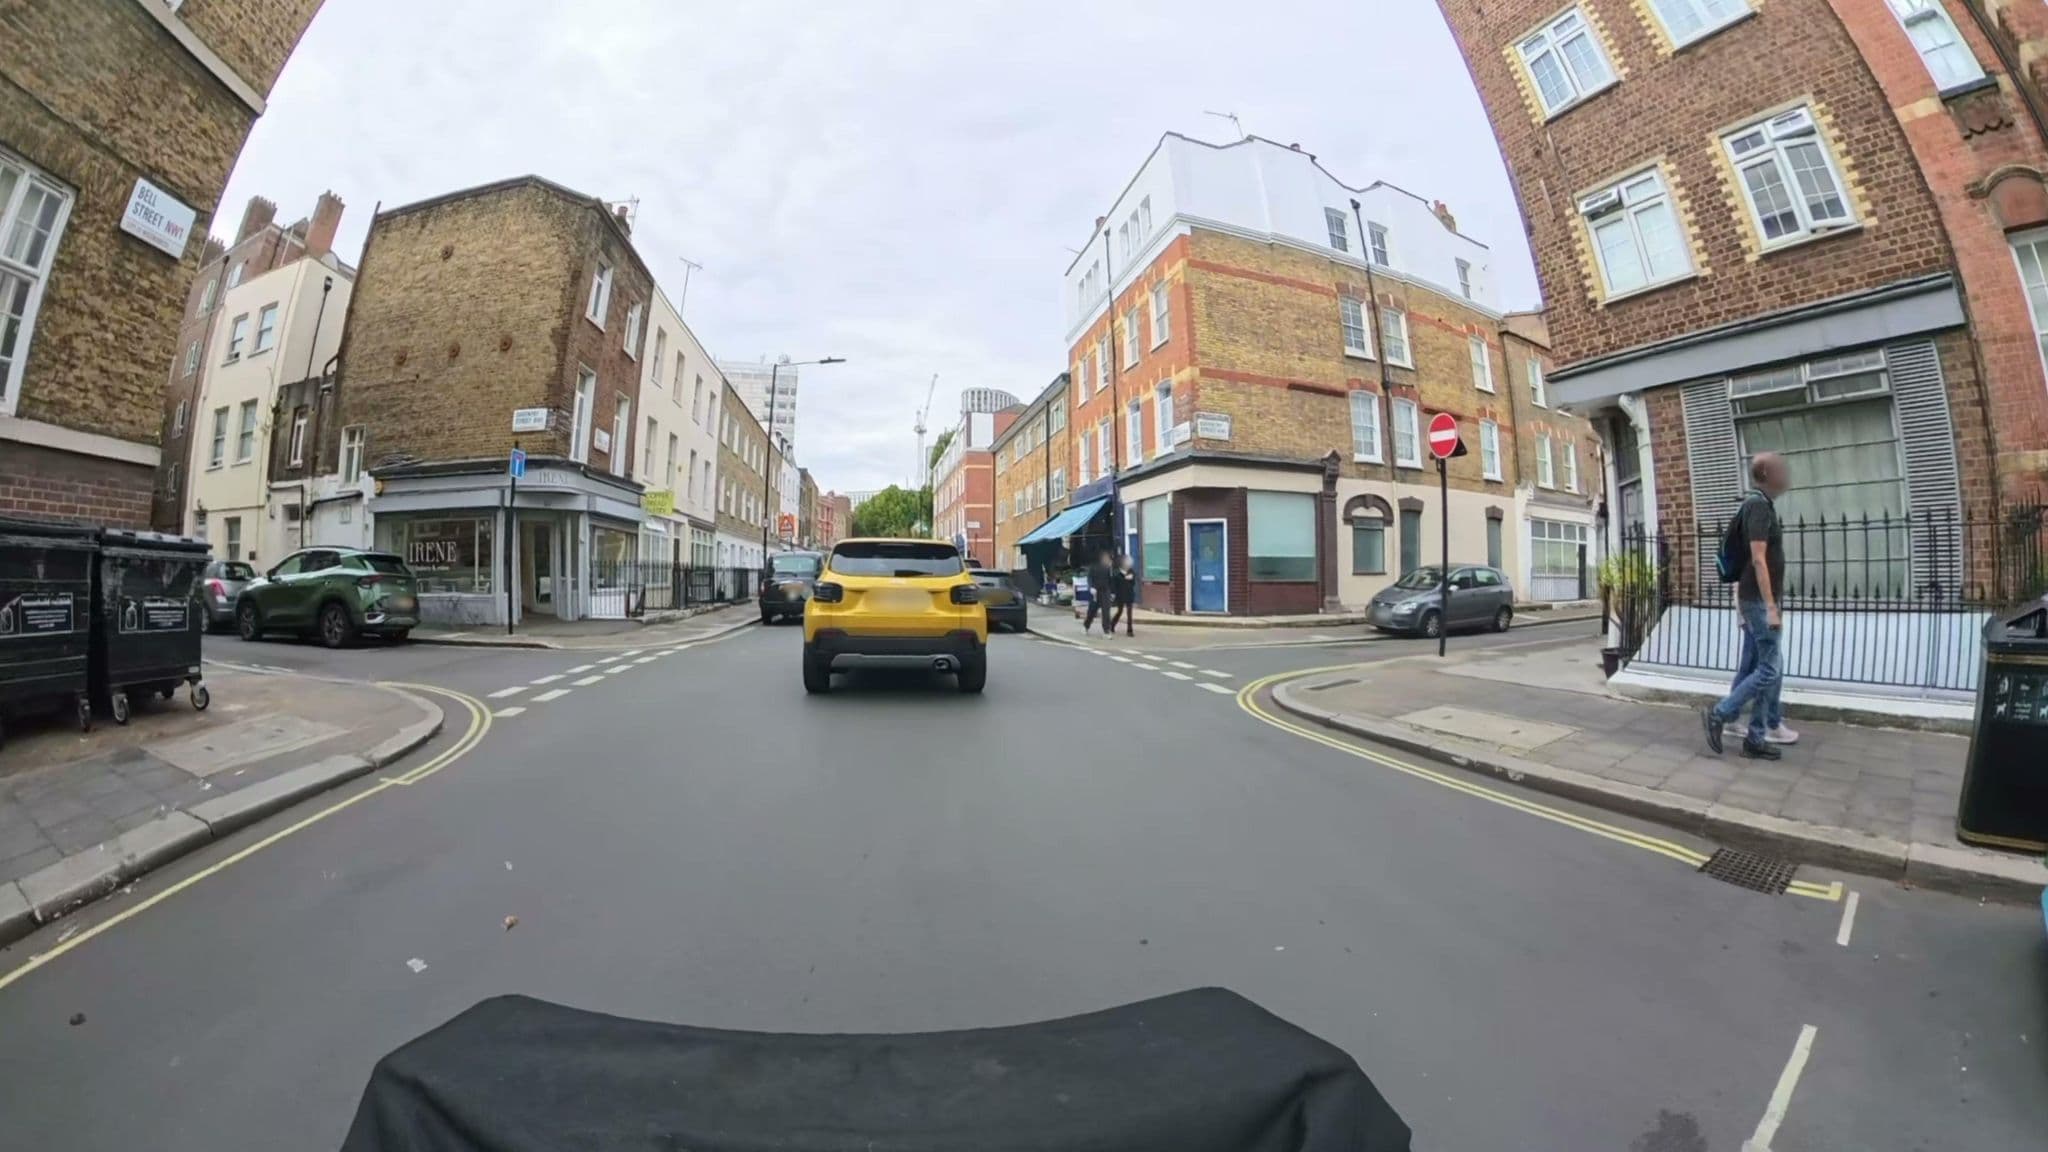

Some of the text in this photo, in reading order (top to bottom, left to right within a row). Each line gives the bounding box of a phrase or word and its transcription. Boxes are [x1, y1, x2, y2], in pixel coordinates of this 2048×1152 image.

[137, 186, 158, 208] BELL
[132, 201, 165, 228] STREET
[165, 220, 185, 240] NW1
[409, 541, 457, 563] IRENE
